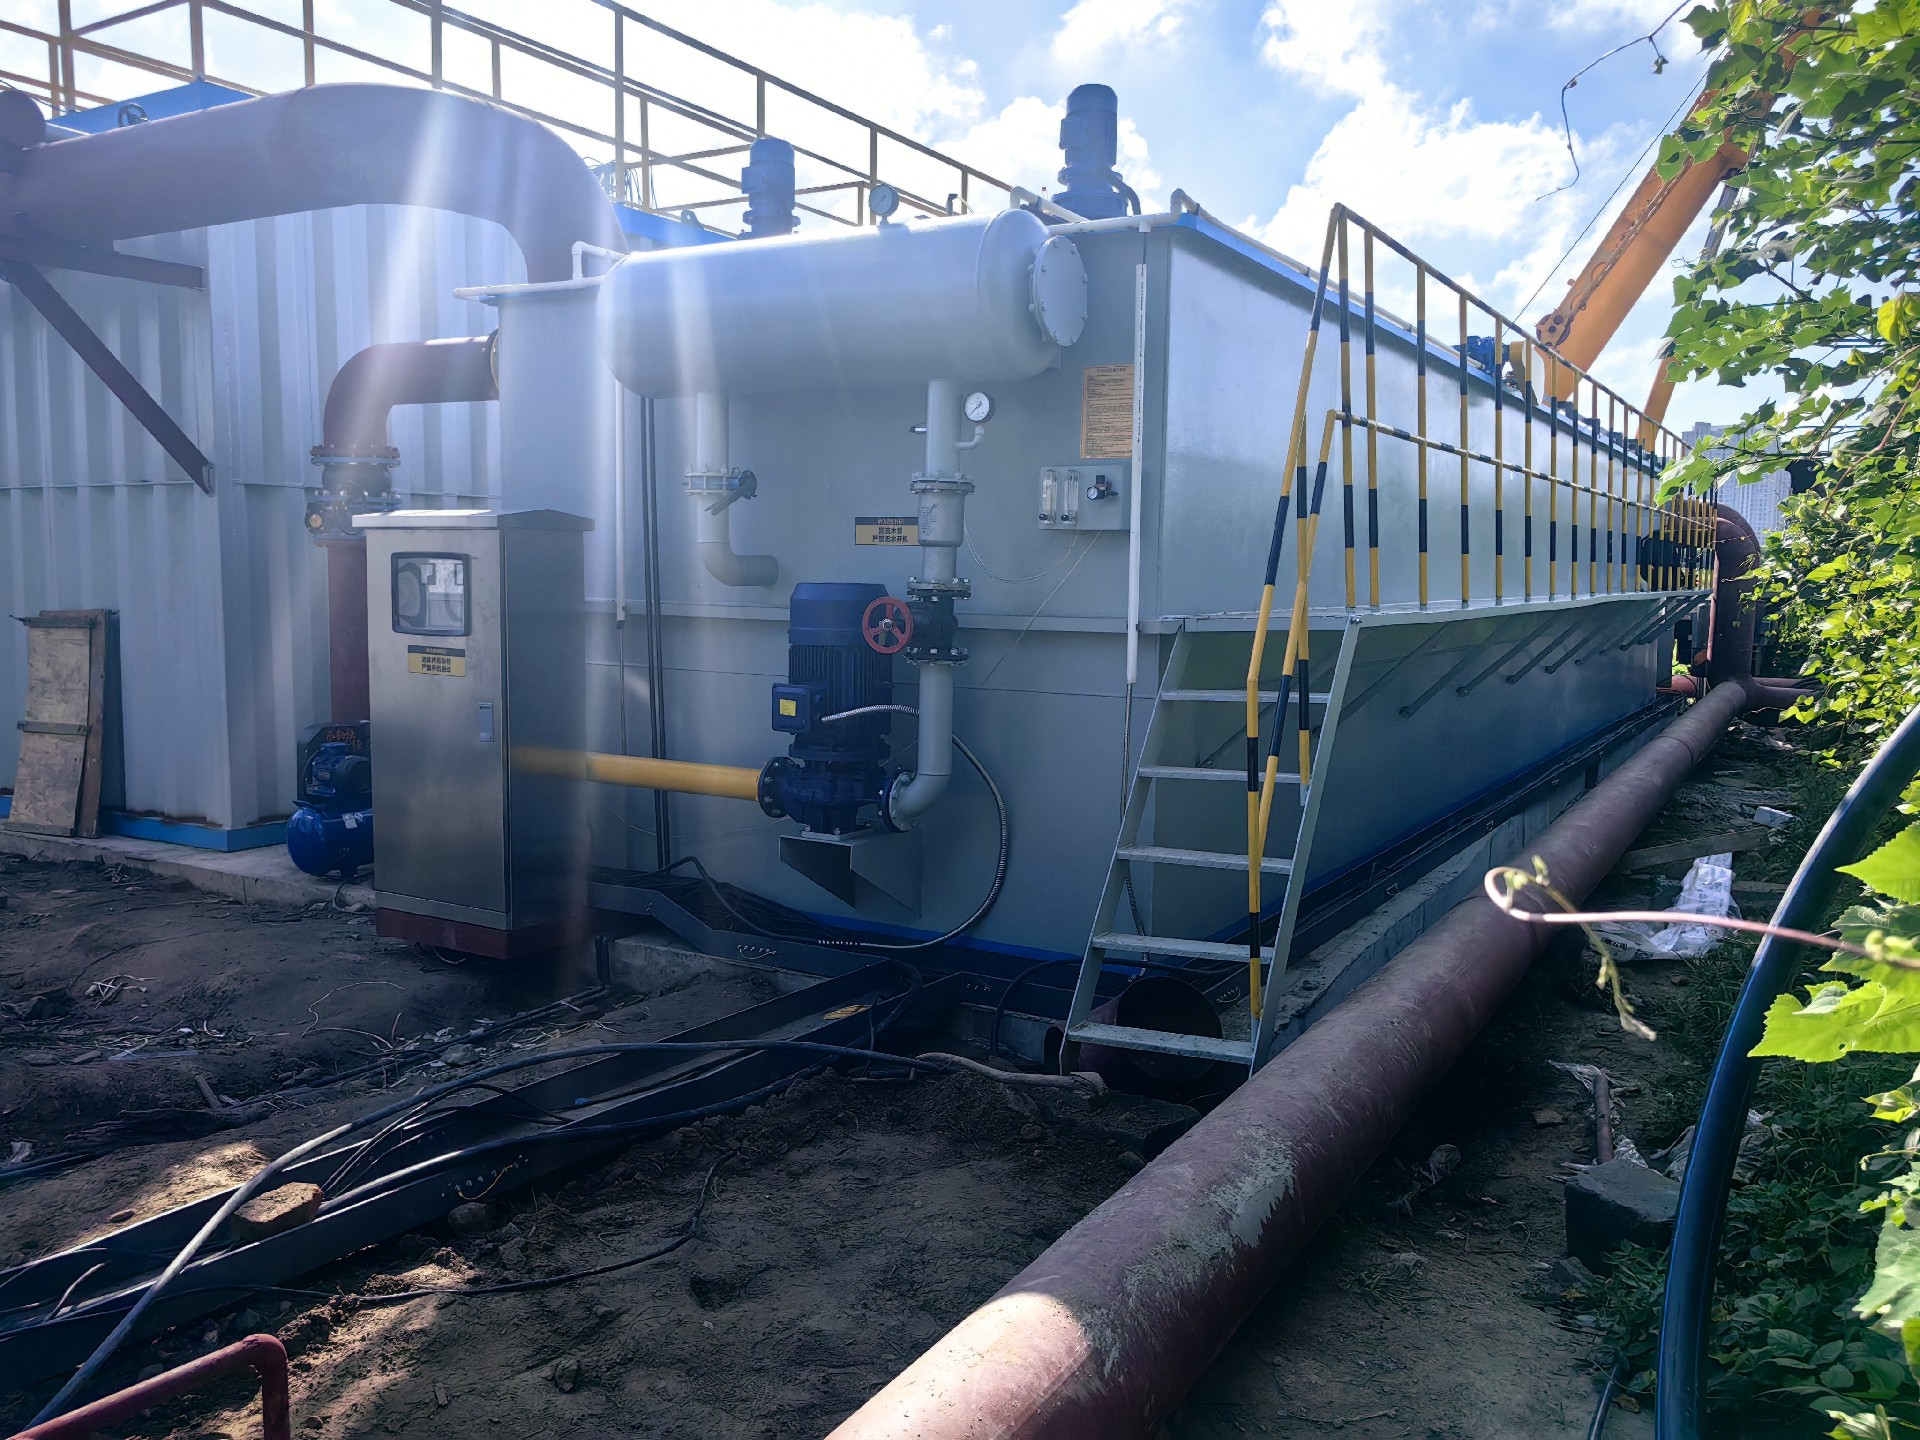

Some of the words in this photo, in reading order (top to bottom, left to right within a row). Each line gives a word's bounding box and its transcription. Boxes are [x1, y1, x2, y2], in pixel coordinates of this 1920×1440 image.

[872, 535, 909, 543] 严禁无水开机
